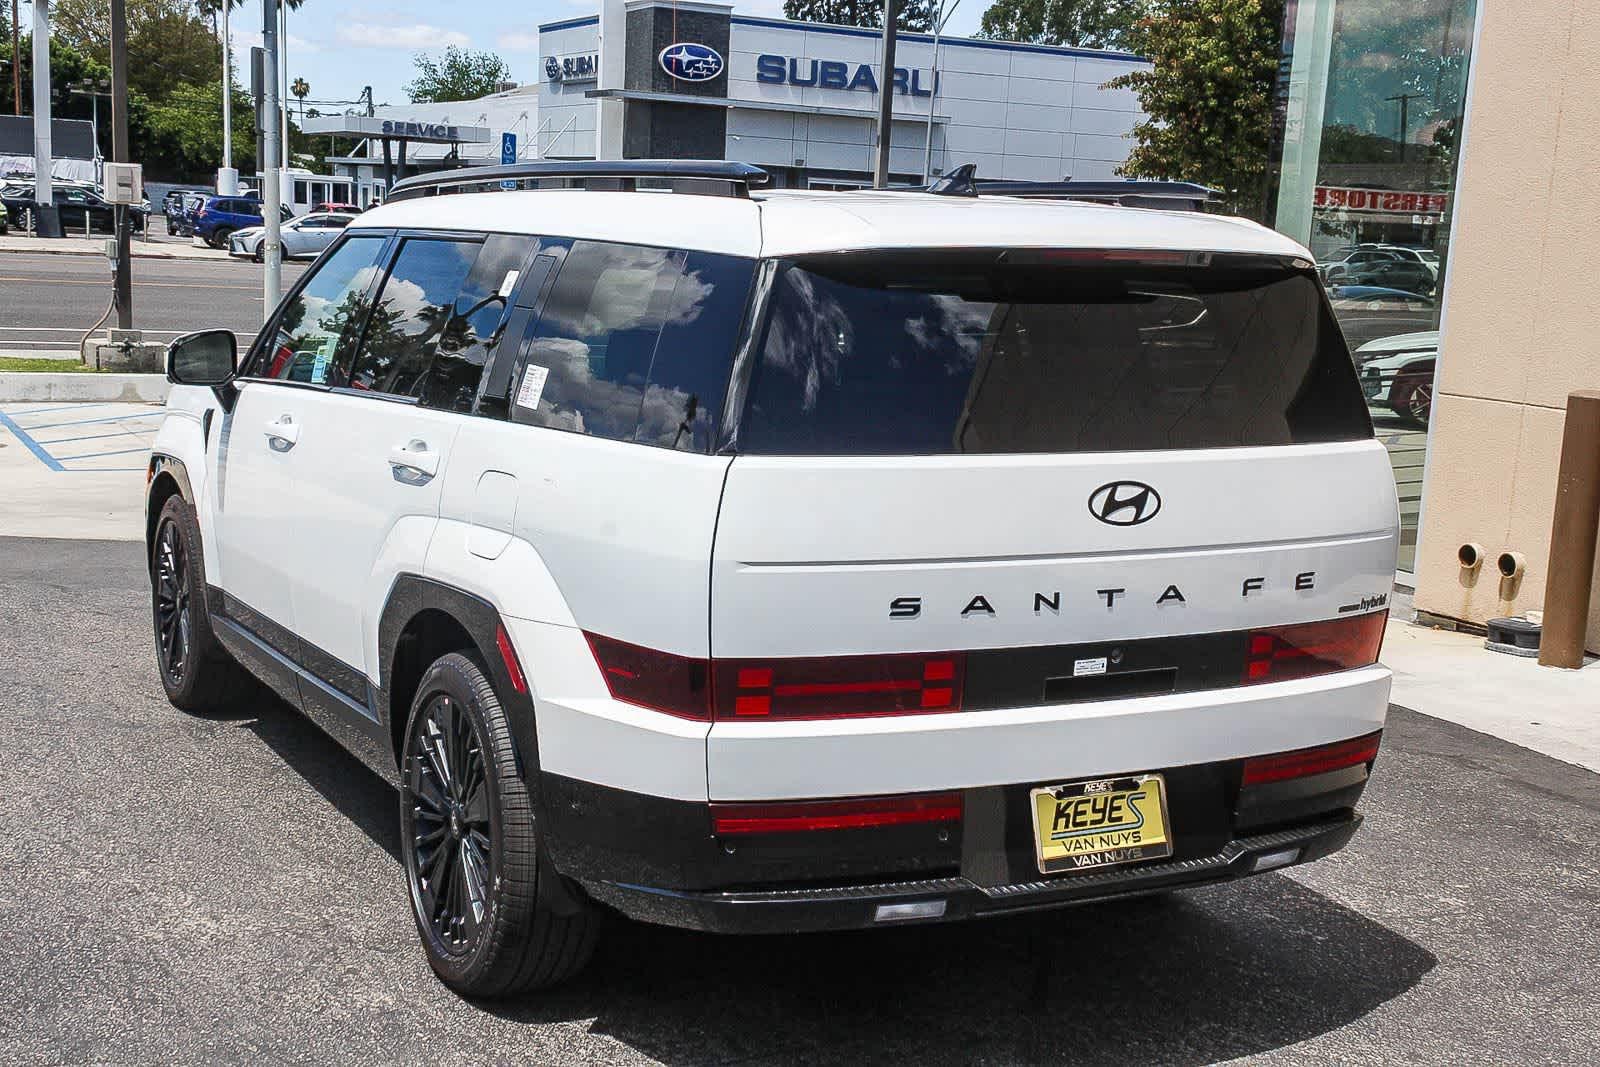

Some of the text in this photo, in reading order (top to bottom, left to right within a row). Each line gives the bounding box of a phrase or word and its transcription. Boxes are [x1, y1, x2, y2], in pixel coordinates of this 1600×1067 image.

[382, 120, 458, 138] SERVICE
[888, 571, 1315, 617] SANTA FE
[1360, 593, 1387, 611] hybrid
[1084, 781, 1114, 793] KEYES
[1051, 792, 1147, 840] KEYES
[1062, 831, 1142, 852] VAN NUYS
[1072, 848, 1143, 867] VAN NUYS
